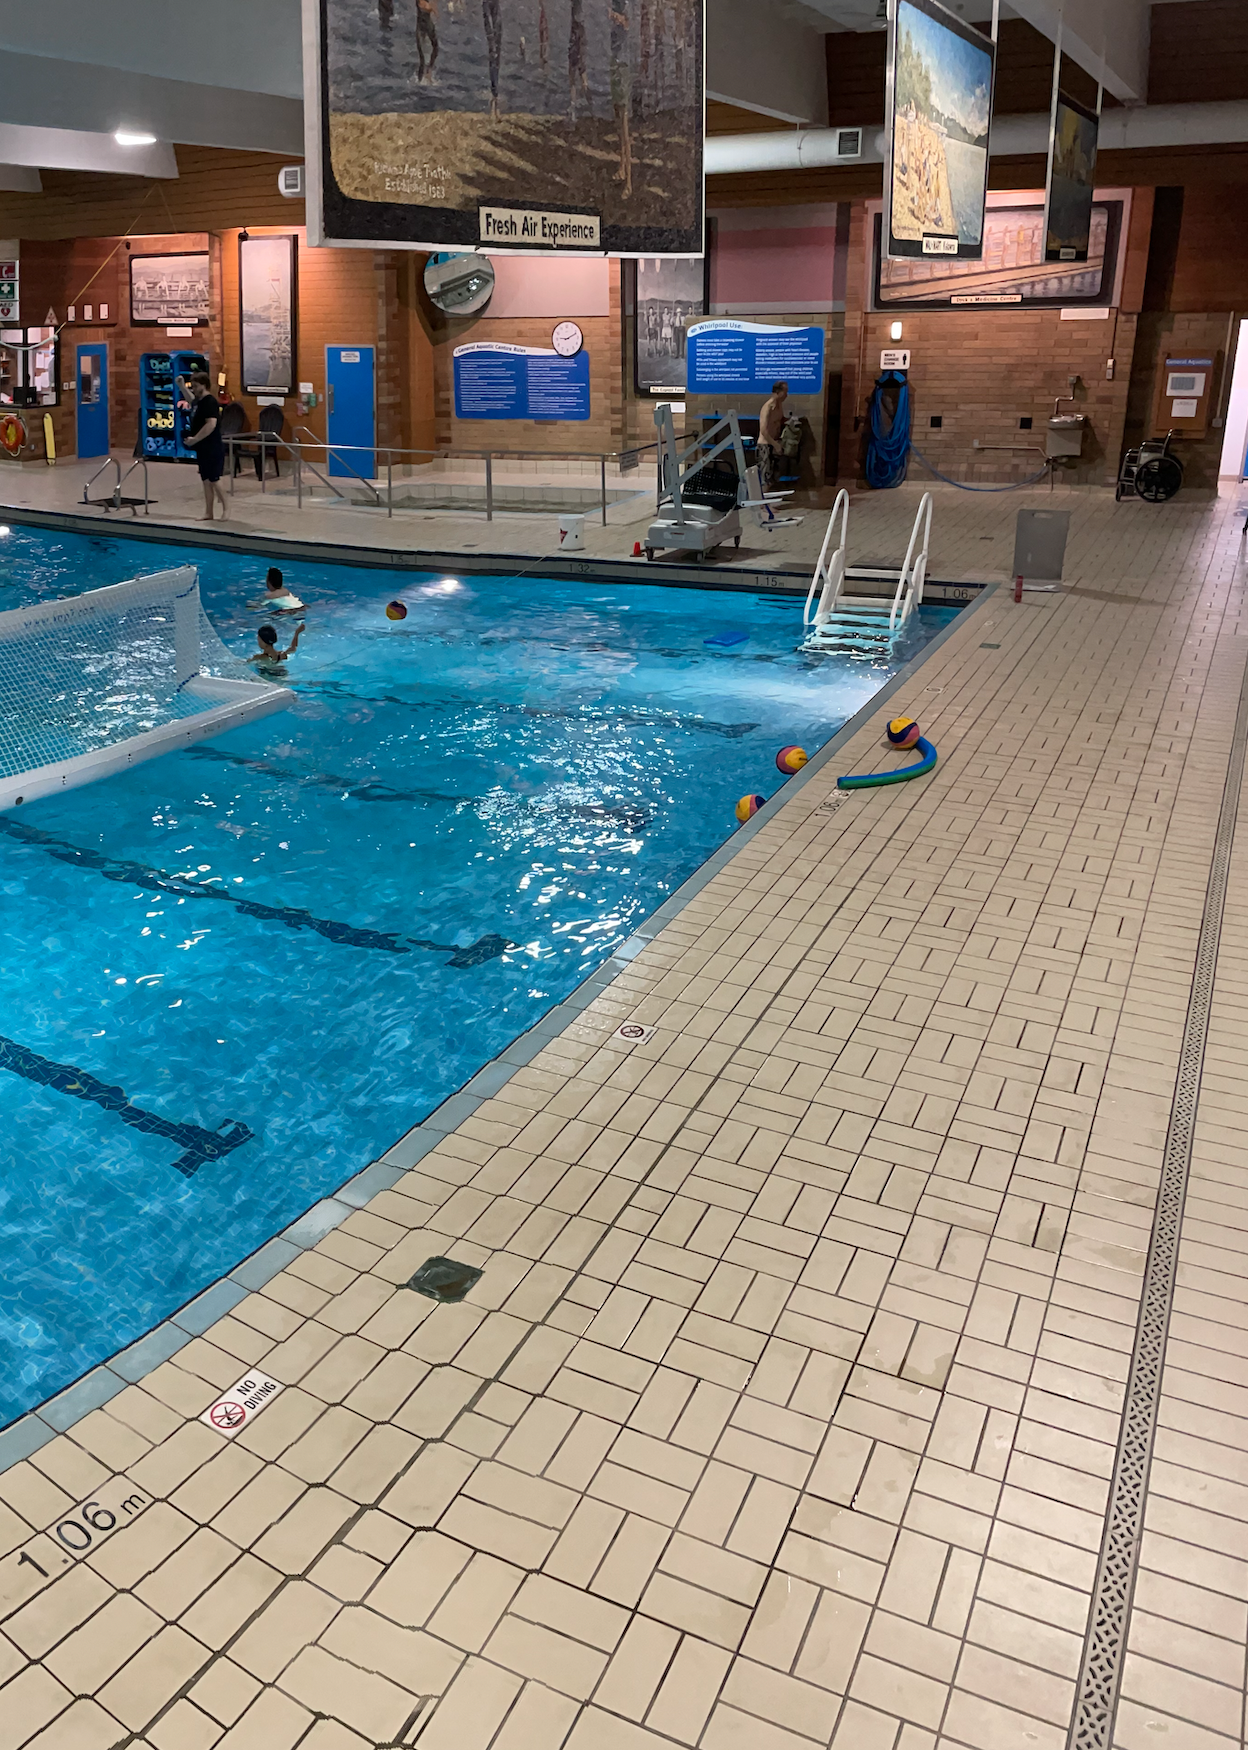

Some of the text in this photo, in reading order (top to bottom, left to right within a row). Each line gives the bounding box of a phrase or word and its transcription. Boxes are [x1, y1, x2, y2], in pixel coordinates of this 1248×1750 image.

[485, 213, 594, 246] Fresh Air Experience
[698, 322, 728, 331] Whirlpool
[457, 345, 475, 353] General
[236, 1379, 257, 1396] NO
[244, 1381, 277, 1410] DIVING
